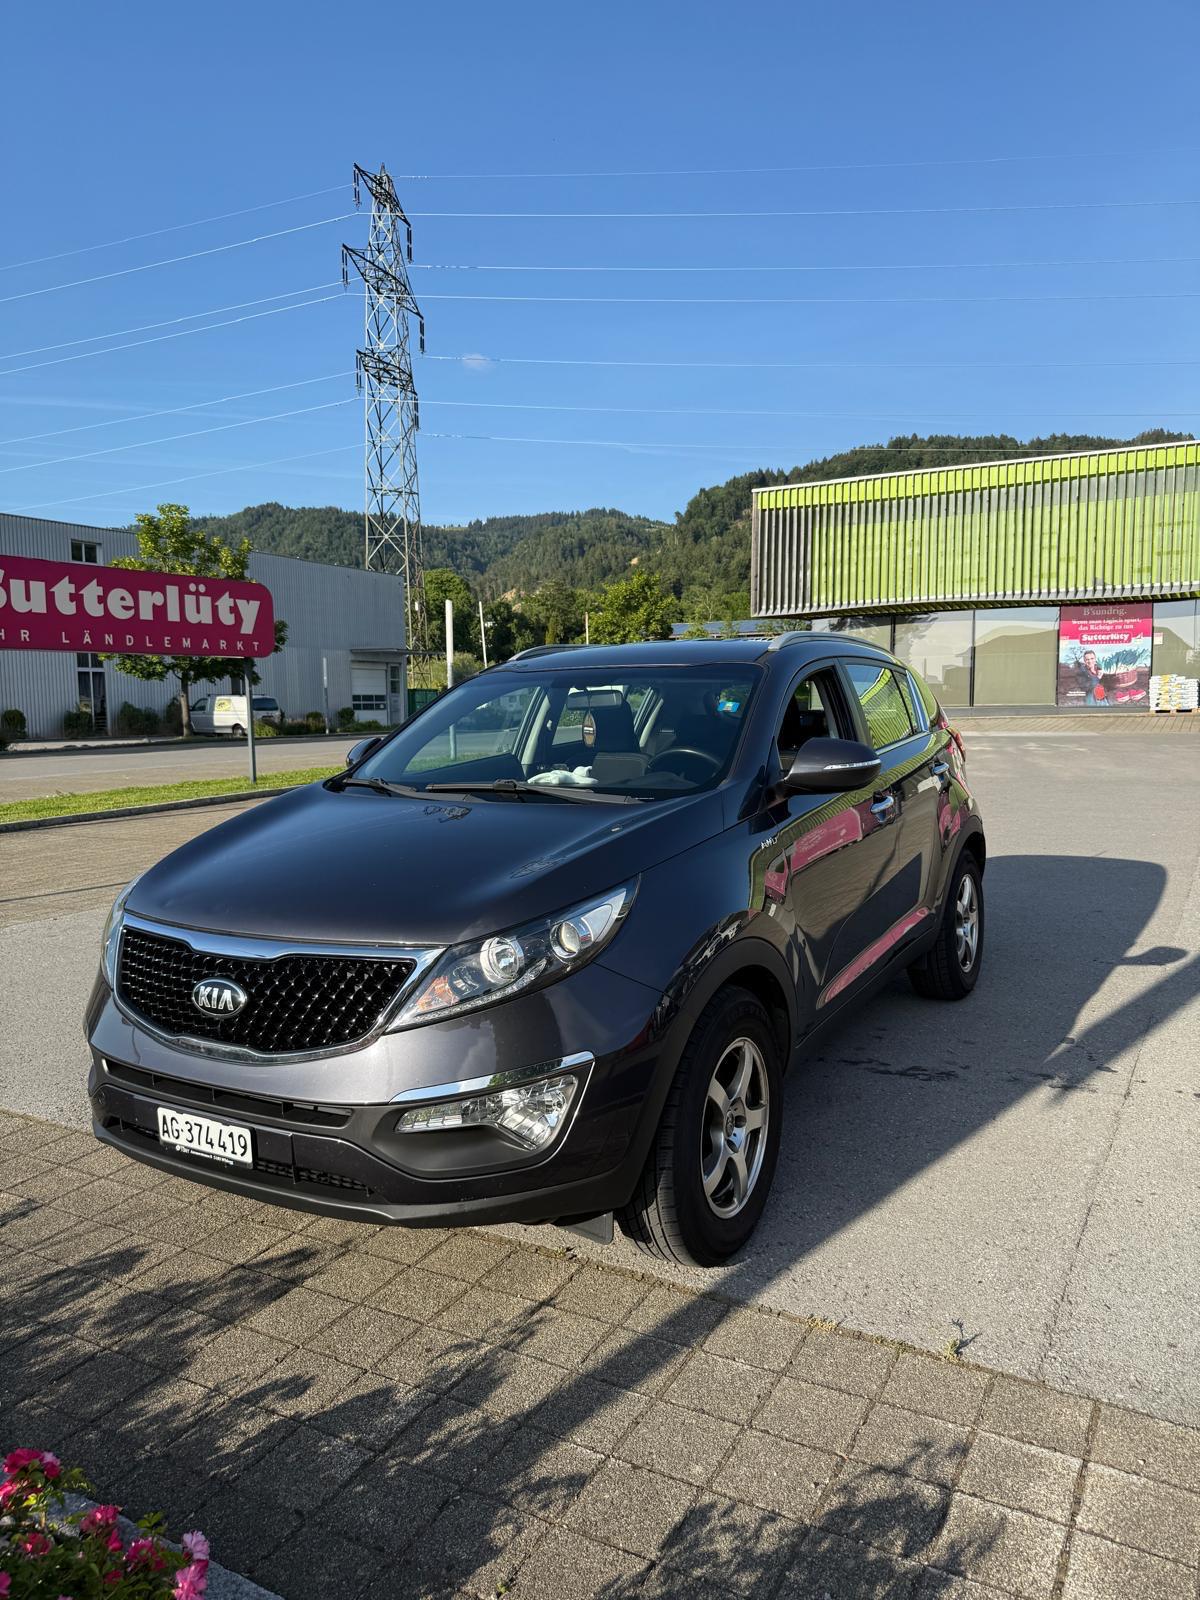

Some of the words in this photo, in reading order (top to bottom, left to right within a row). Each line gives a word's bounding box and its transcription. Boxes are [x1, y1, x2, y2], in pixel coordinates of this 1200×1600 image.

[0, 569, 260, 634] utterlüty
[62, 630, 260, 652] LÄNDLEMARKT
[1082, 633, 1129, 641] Sutterlüty
[199, 986, 234, 1011] KIA
